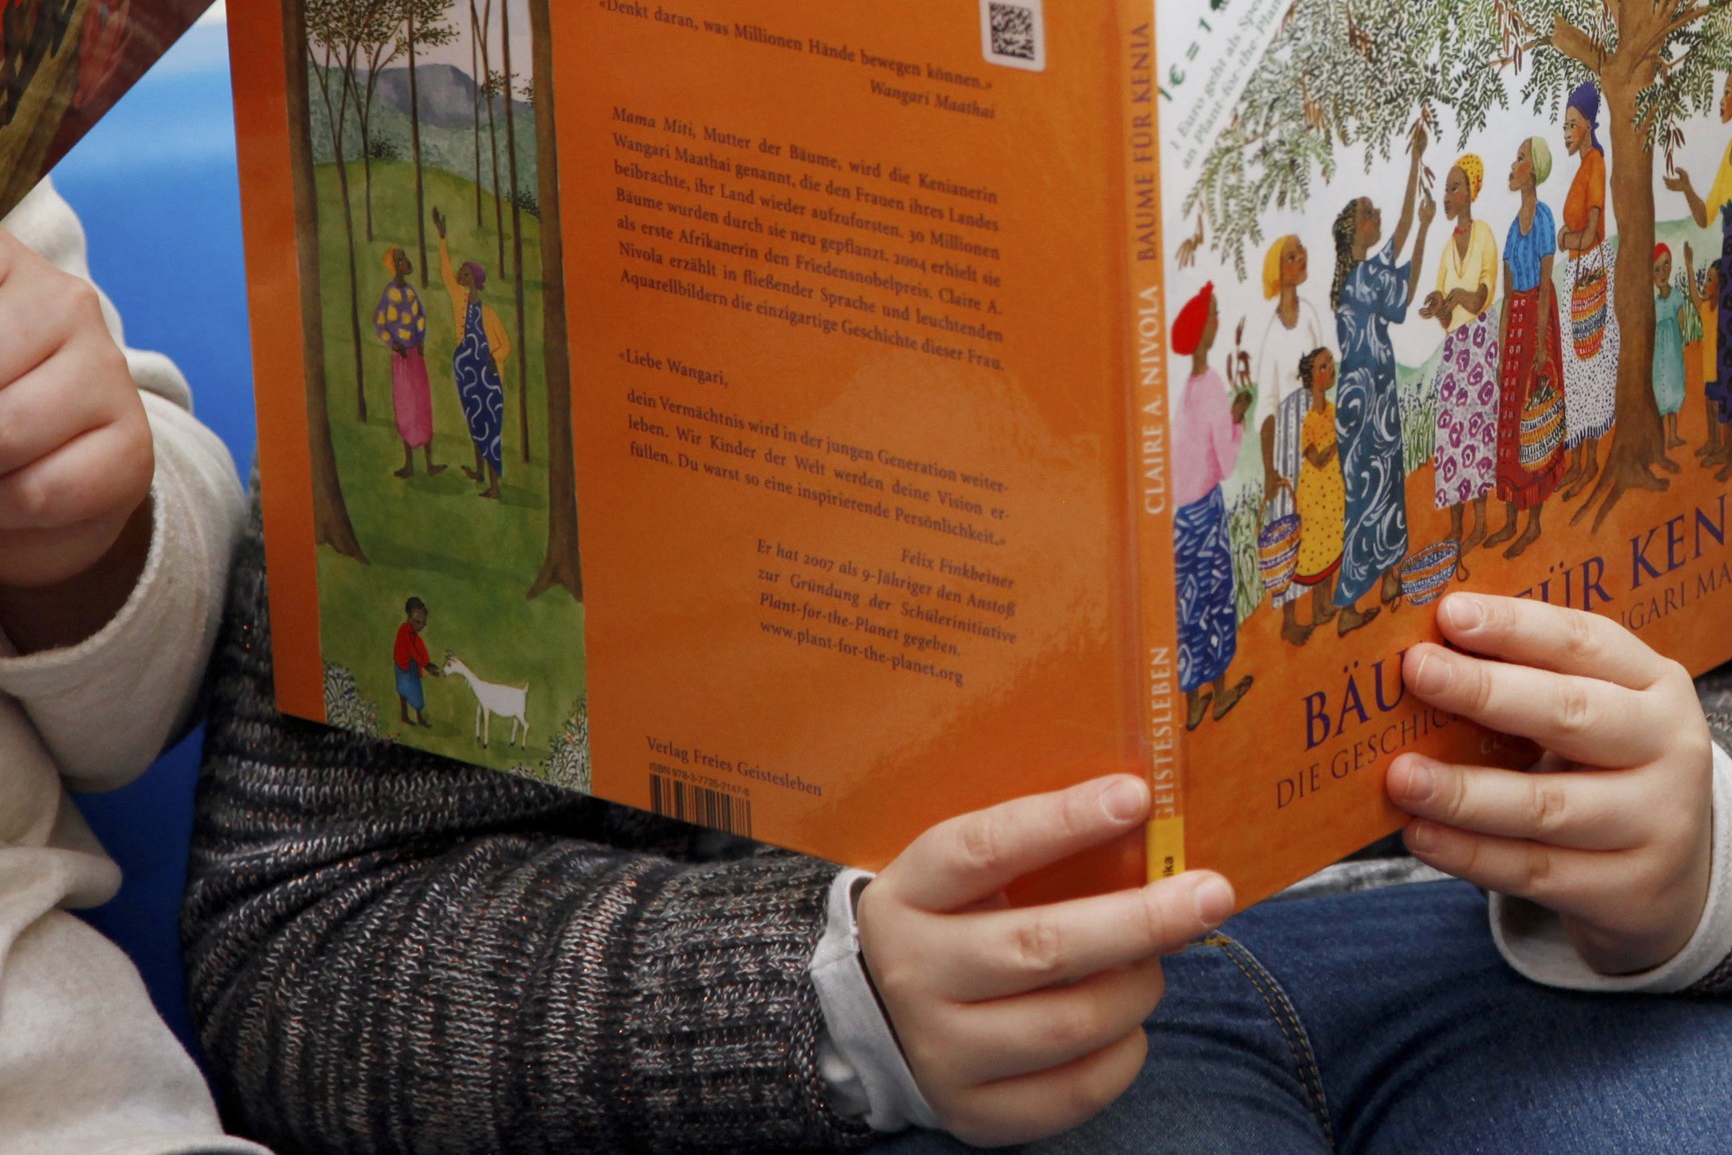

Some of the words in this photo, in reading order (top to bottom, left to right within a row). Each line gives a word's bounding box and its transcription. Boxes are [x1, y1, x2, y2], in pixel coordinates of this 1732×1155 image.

[654, 6, 698, 30] daran,
[703, 21, 729, 36] was
[734, 24, 802, 50] Millionen
[809, 39, 856, 62] Hände
[860, 49, 922, 77] bewegen
[1130, 23, 1152, 103] KENIA
[1157, 85, 1172, 102] 1
[1168, 63, 1185, 87] €
[1186, 40, 1200, 61] =
[1199, 17, 1212, 32] 1
[870, 79, 930, 105] Wangari
[935, 94, 995, 118] Maathai
[1177, 98, 1205, 138] Euro
[1204, 57, 1227, 98] geht
[1225, 32, 1241, 59] als
[612, 106, 656, 128] Mama
[663, 117, 696, 139] Miti,
[704, 126, 751, 148] Mutter
[758, 138, 782, 156] der
[790, 144, 842, 170] Bäume,
[849, 160, 882, 178] wird
[889, 167, 911, 184] die
[918, 173, 998, 203] Kenianerin
[1133, 112, 1153, 163] FÜR
[1182, 147, 1197, 169] an
[612, 132, 670, 158] Wangari
[675, 147, 731, 172] Maathai
[735, 164, 796, 187] genannt,
[799, 174, 821, 191] die
[825, 180, 851, 198] den
[856, 186, 904, 210] Frauen
[909, 198, 944, 219] ihres
[949, 207, 999, 231] Landes
[614, 159, 690, 190] beibrachte,
[695, 178, 715, 195] ihr
[720, 183, 755, 204] Land
[759, 195, 806, 215] wieder
[811, 208, 904, 237] aufzuforsten.
[910, 230, 925, 243] 30
[930, 231, 1000, 259] Millionen
[1135, 173, 1157, 262] BÄUME
[616, 187, 664, 211] Bäume
[667, 203, 719, 223] wurden
[722, 211, 764, 233] durch
[768, 222, 787, 238] sie
[790, 230, 816, 245] neu
[820, 237, 889, 261] gepflanzt.
[894, 254, 927, 273] 2004
[930, 261, 977, 282] erhielt
[982, 271, 1001, 287] sie
[617, 215, 636, 231] als
[640, 224, 674, 239] erste
[678, 229, 758, 259] Afrikanerin
[764, 248, 790, 266] den
[796, 255, 932, 298] Friedensnobelpreis.
[938, 288, 981, 310] Claire
[988, 300, 1002, 314] A.
[619, 241, 664, 264] Nivola
[669, 257, 716, 276] erzählt
[723, 265, 737, 281] in
[743, 269, 814, 298] fließender
[820, 287, 876, 313] Sprache
[882, 306, 910, 321] und
[916, 309, 1004, 342] leuchtenden
[620, 270, 728, 305] Aquarellbildern
[731, 293, 752, 311] die
[756, 302, 838, 334] einzigartige
[841, 320, 918, 349] Geschichte
[921, 338, 963, 360] dieser
[968, 348, 1004, 370] Frau.
[666, 358, 728, 386] Wangari,
[1138, 286, 1162, 385] NIVOLA
[627, 389, 656, 408] dein
[659, 396, 745, 429] Vermächtnis
[748, 420, 780, 438] wird
[783, 425, 797, 442] in
[800, 430, 823, 448] der
[827, 437, 874, 461] jungen
[877, 449, 956, 481] Generation
[1142, 394, 1163, 416] A.
[628, 414, 668, 437] leben.
[676, 426, 702, 445] Wir
[710, 434, 757, 458] Kinder
[764, 448, 787, 466] der
[794, 455, 826, 475] Welt
[834, 469, 884, 490] werden
[892, 479, 930, 501] deine
[937, 490, 982, 514] Vision
[630, 441, 673, 464] füllen.
[678, 453, 698, 471] Du
[704, 464, 740, 481] warst
[745, 474, 760, 486] so
[764, 476, 793, 494] eine
[798, 483, 890, 518] inspirierende
[1142, 425, 1166, 514] CLAIRE
[757, 538, 772, 554] Er
[776, 543, 799, 561] hat
[803, 554, 835, 572] 2007
[839, 561, 858, 576] als
[862, 569, 933, 596] 9-Jähriger
[936, 585, 962, 603] den
[966, 593, 1016, 619] Anstoß
[758, 569, 780, 582] zur
[790, 574, 860, 607] Gründung
[868, 593, 892, 610] der
[901, 602, 1017, 643] Schülerinitiative
[901, 548, 934, 570] Felix
[939, 558, 1014, 588] Finkbeiner
[760, 593, 899, 639] Plant-for-the-Planet
[902, 633, 960, 655] gegeben.
[760, 623, 964, 687] www.plant-for-the-planet.org
[1276, 763, 1320, 810] DIE
[1331, 707, 1458, 779] GESCHIC
[1621, 582, 1685, 631] GARI
[1301, 648, 1409, 751] BÄU
[646, 736, 689, 764] Verlag
[694, 749, 733, 772] Freies
[737, 762, 822, 796] Geistesleben
[650, 762, 670, 775] ISBN
